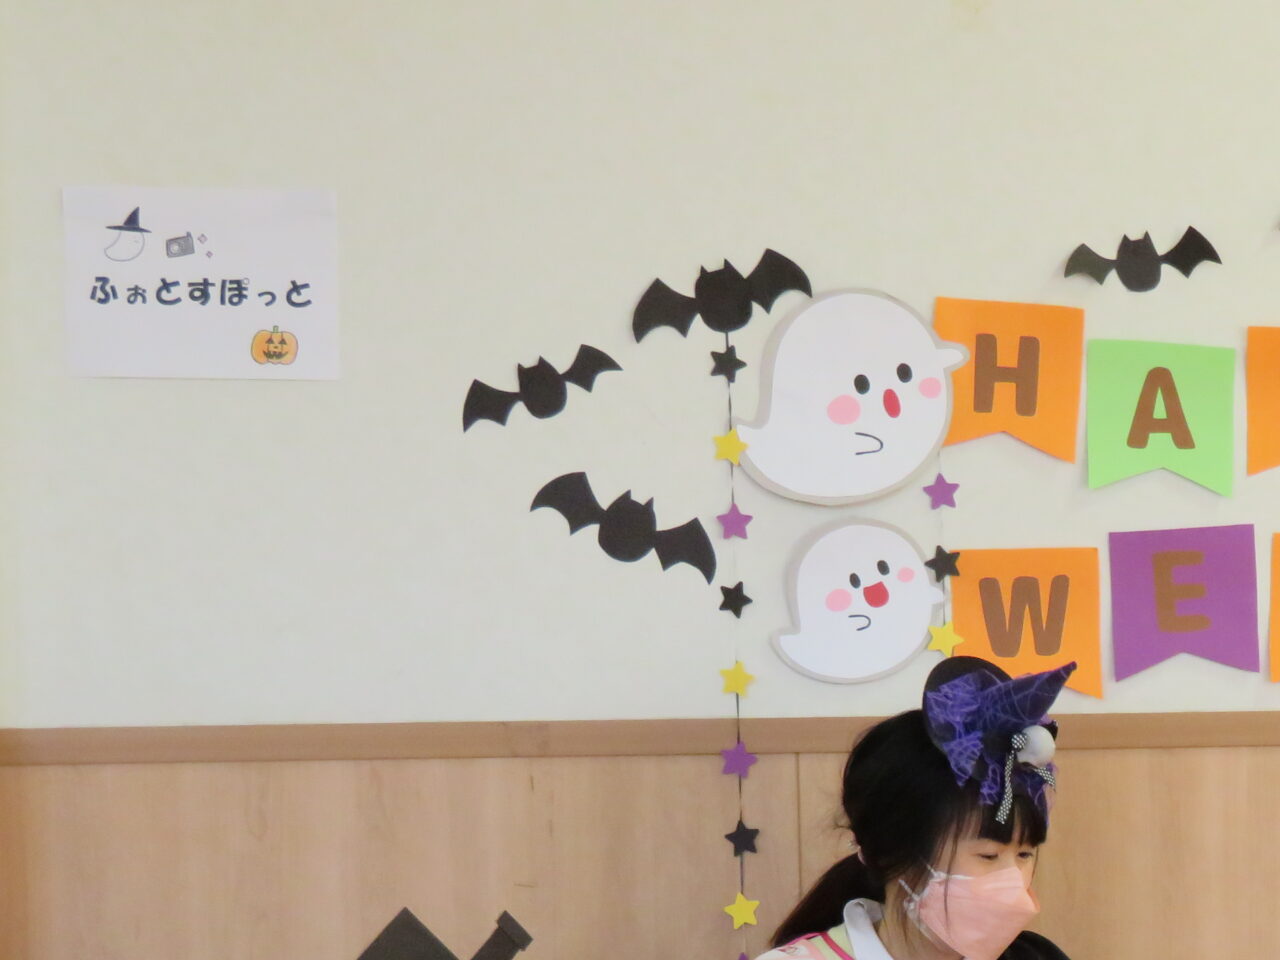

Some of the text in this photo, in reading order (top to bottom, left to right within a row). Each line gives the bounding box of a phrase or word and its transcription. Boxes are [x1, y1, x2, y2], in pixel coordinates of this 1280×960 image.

[89, 276, 312, 308] ふぉとすぽっと
